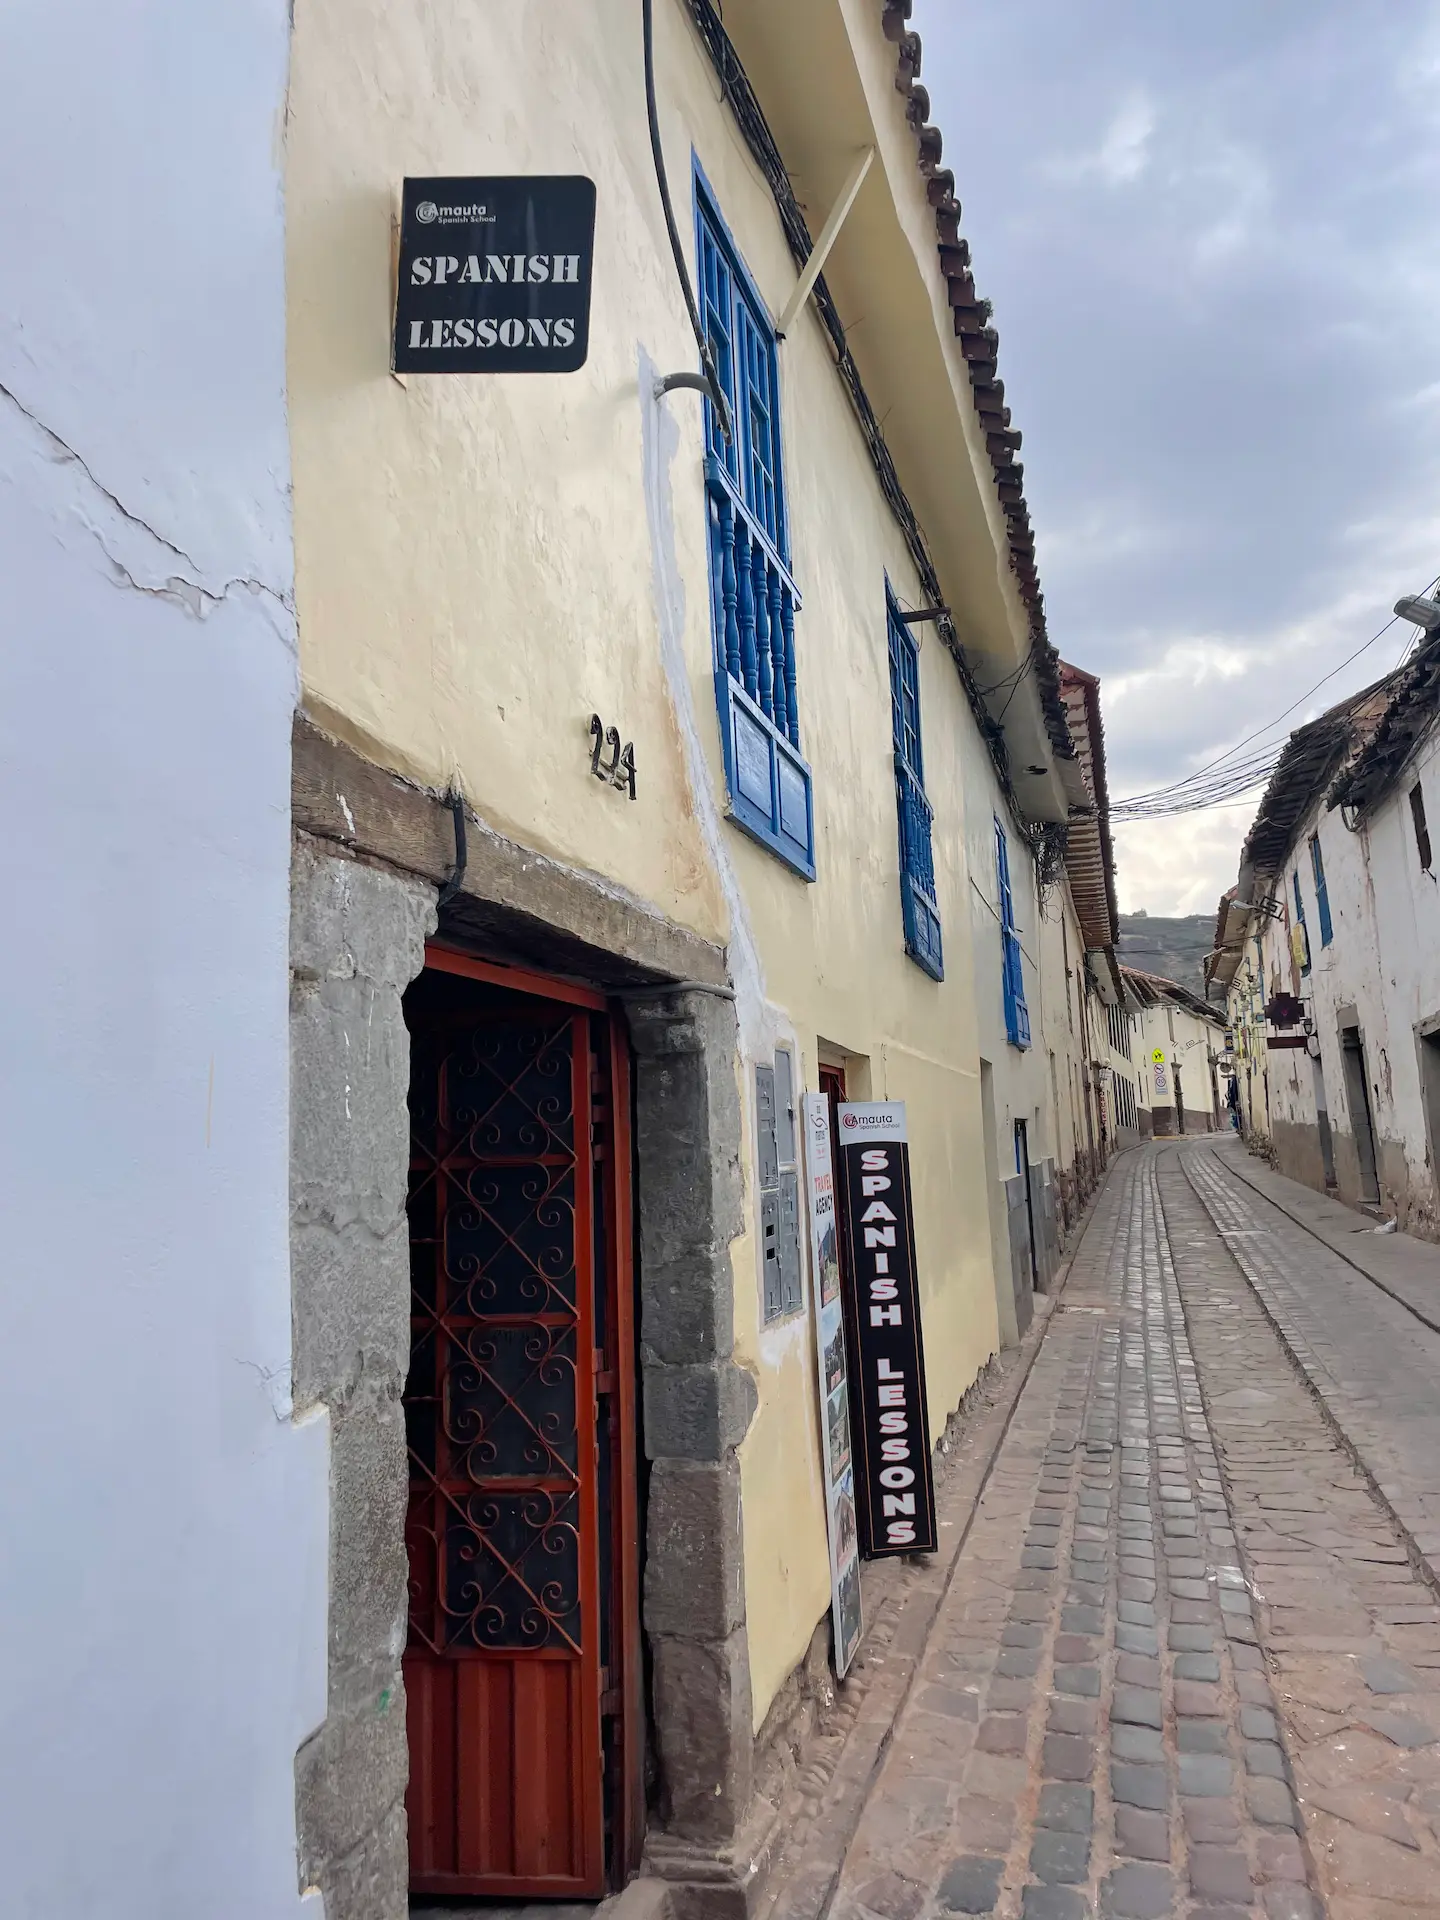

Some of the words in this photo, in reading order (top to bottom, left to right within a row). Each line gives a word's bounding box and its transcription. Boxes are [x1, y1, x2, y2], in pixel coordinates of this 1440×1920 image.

[429, 203, 487, 216] Amauta
[437, 215, 469, 225] Spanish
[470, 215, 496, 223] School
[410, 254, 581, 286] SPANISH
[408, 317, 576, 348] LESSONS
[589, 713, 638, 800] 224
[851, 1115, 893, 1125] Amauta
[814, 1174, 832, 1195] TRAVEL
[861, 1149, 903, 1327] SPANISH
[876, 1357, 917, 1545] LESSONS
